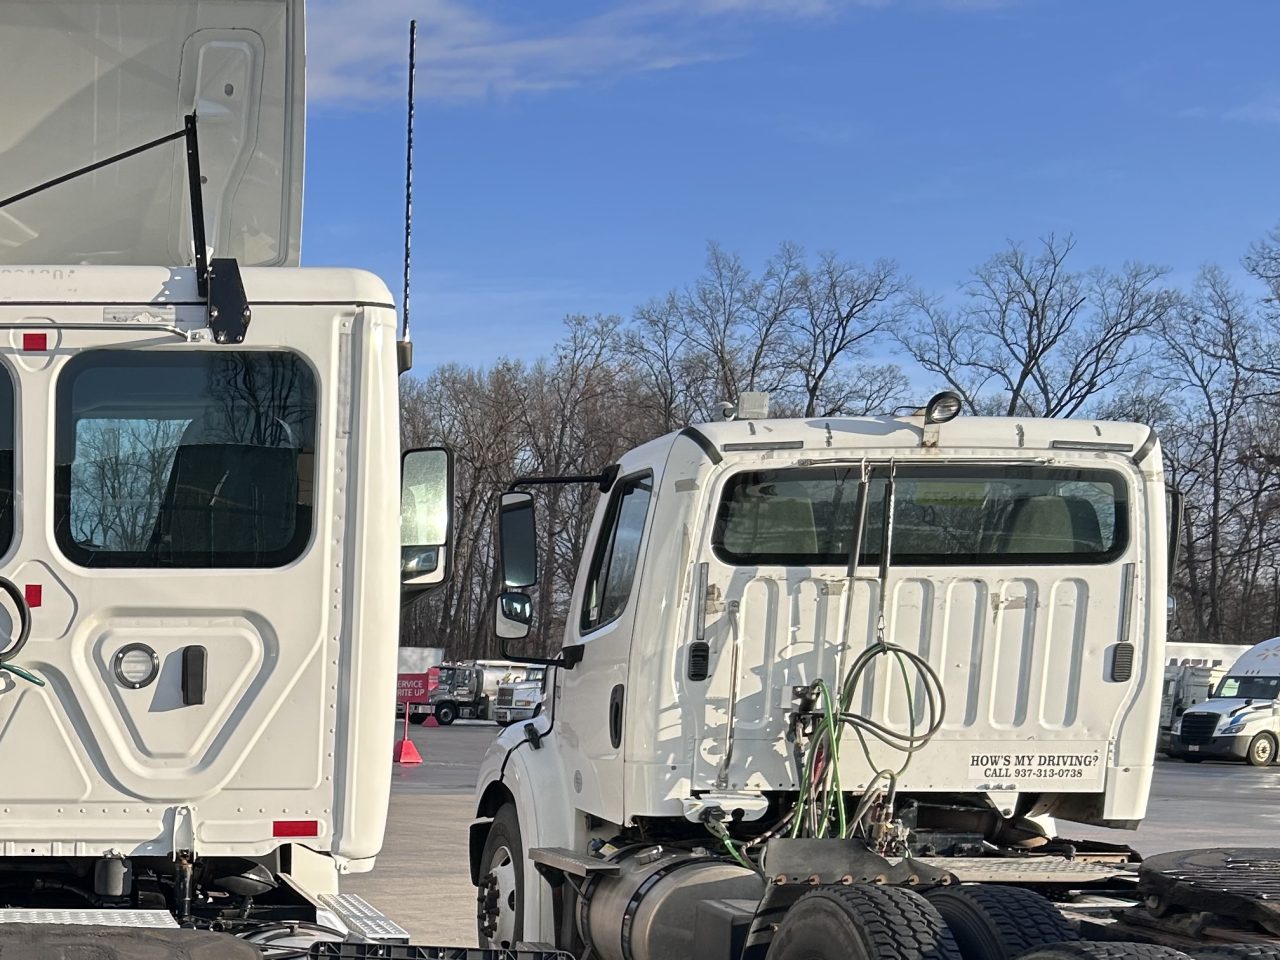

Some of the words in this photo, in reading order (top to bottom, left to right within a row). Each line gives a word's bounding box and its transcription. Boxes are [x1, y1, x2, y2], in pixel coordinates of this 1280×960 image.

[397, 680, 424, 689] ERVICE
[397, 688, 413, 697] RITE
[414, 688, 425, 697] UP
[970, 755, 1011, 767] HOW'S
[1014, 755, 1035, 767] MY
[1038, 755, 1099, 767] DRIVING?
[984, 768, 1011, 778] CALL
[1014, 768, 1083, 778] 937-313-0738
